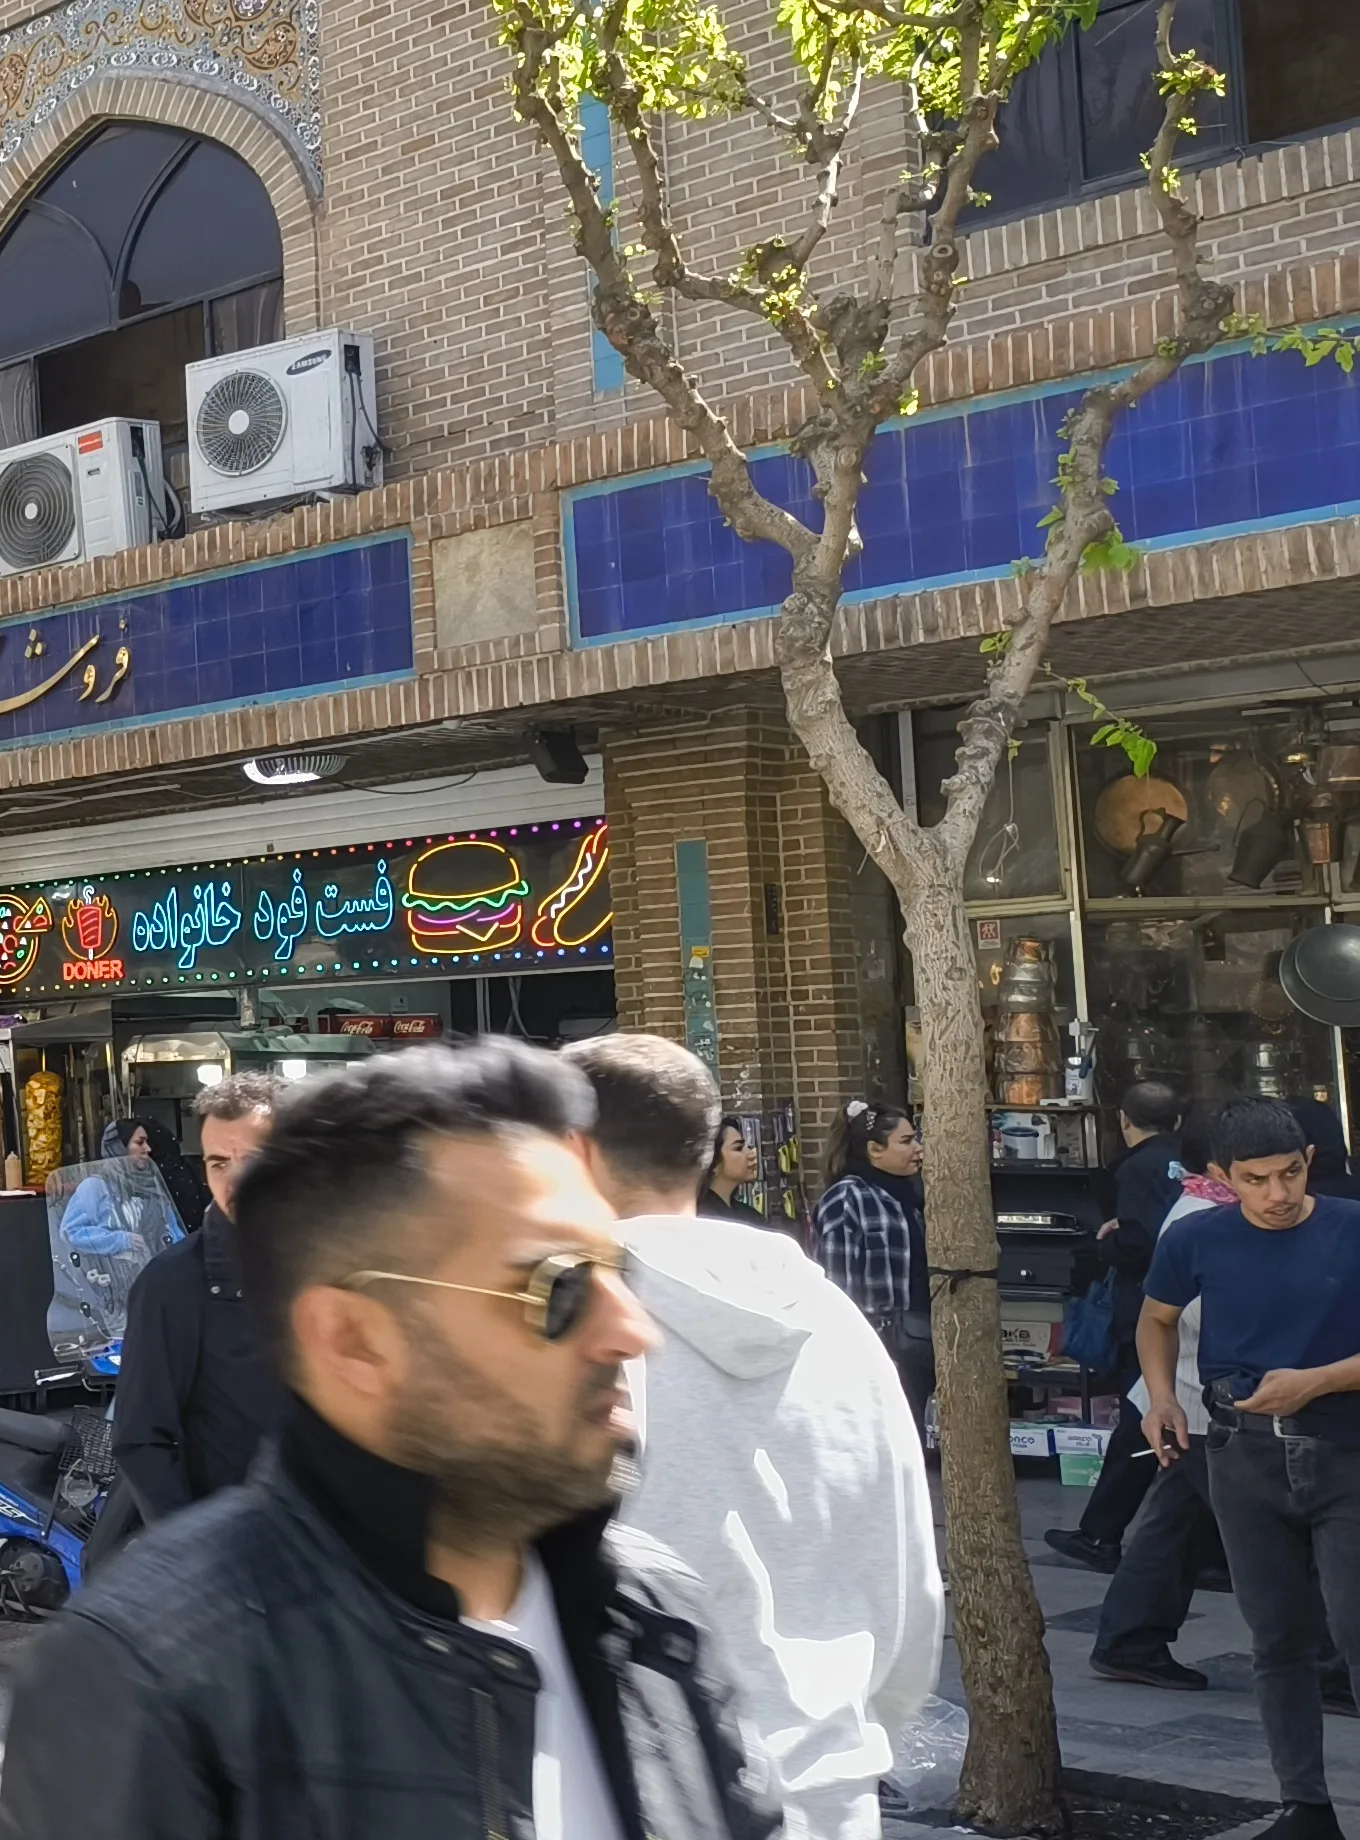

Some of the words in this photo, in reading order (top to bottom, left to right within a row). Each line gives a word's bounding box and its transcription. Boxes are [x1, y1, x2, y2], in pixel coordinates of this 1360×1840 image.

[132, 881, 242, 969] خانواده
[253, 868, 309, 961] فود
[314, 859, 392, 935] فست
[62, 958, 124, 982] DONER
